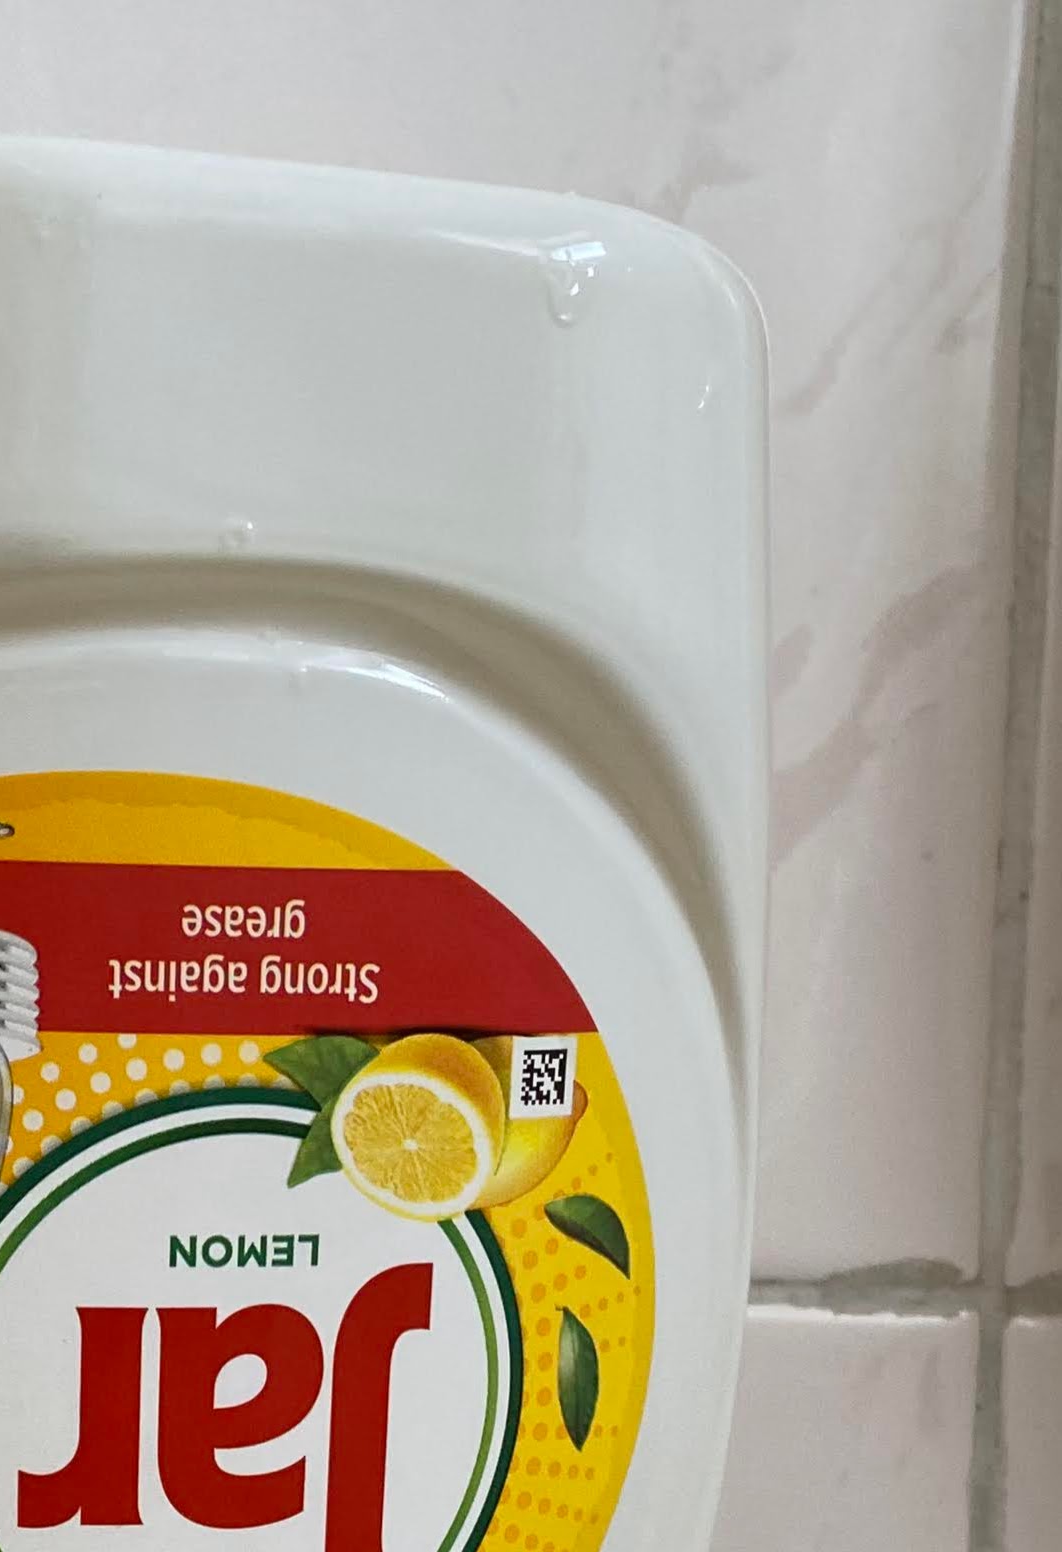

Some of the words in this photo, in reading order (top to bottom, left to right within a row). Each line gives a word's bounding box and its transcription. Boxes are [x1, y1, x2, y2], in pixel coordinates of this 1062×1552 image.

[181, 899, 306, 939] grease
[108, 953, 248, 1002] against
[260, 954, 381, 1004] Strong
[168, 1233, 320, 1268] LEMON
